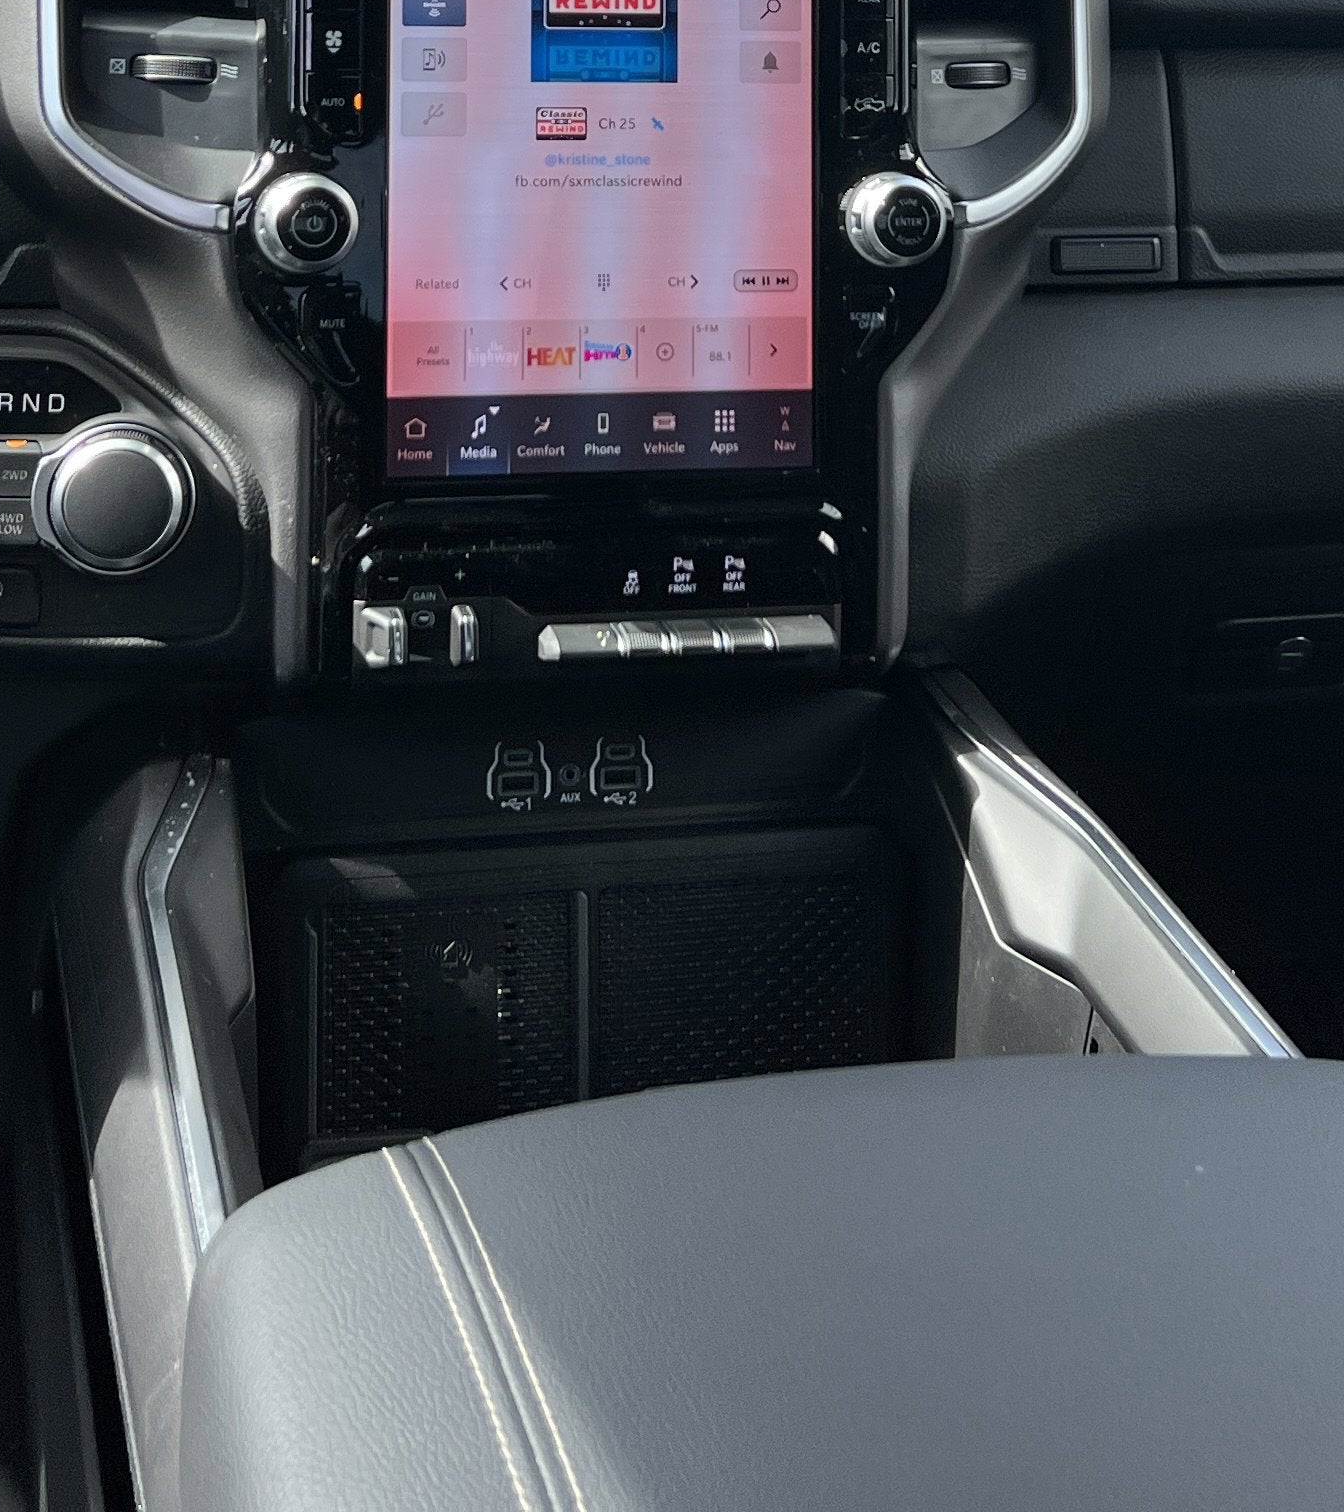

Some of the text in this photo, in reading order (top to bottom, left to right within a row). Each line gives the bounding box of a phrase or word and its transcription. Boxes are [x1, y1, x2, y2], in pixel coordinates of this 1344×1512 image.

[857, 41, 881, 53] A/C
[321, 97, 345, 107] AUTO
[540, 109, 585, 119] Classic
[539, 125, 585, 134] REWIND
[599, 118, 636, 130] Ch 25
[544, 153, 651, 168] @kristine_stone
[515, 174, 682, 190] fb.com/sxmclassicrewind
[895, 217, 922, 227] ENTER
[415, 278, 460, 290] Related
[514, 278, 532, 290] CH
[667, 276, 686, 288] CH
[320, 318, 346, 328] MUTE
[526, 327, 533, 336] 2
[583, 326, 589, 335] 3
[640, 325, 646, 334] 4
[427, 345, 439, 355] All
[416, 356, 450, 367] Presets
[468, 347, 519, 367] highway
[527, 347, 576, 366] HEAT
[709, 351, 732, 363] 88.1
[22, 393, 40, 413] N
[48, 393, 65, 413] D
[517, 444, 565, 458] Comfort
[584, 442, 621, 456] Phone
[643, 441, 685, 454] Vehicle
[710, 440, 739, 455] Apps
[774, 439, 796, 452] Nav
[397, 448, 433, 461] Home
[460, 445, 498, 460] Media
[1, 469, 28, 480] 2WD
[674, 573, 691, 583] OFF
[668, 583, 697, 594] FRONT
[413, 591, 436, 601] GAIN
[560, 792, 581, 803] AUX
[629, 791, 637, 805] 2
